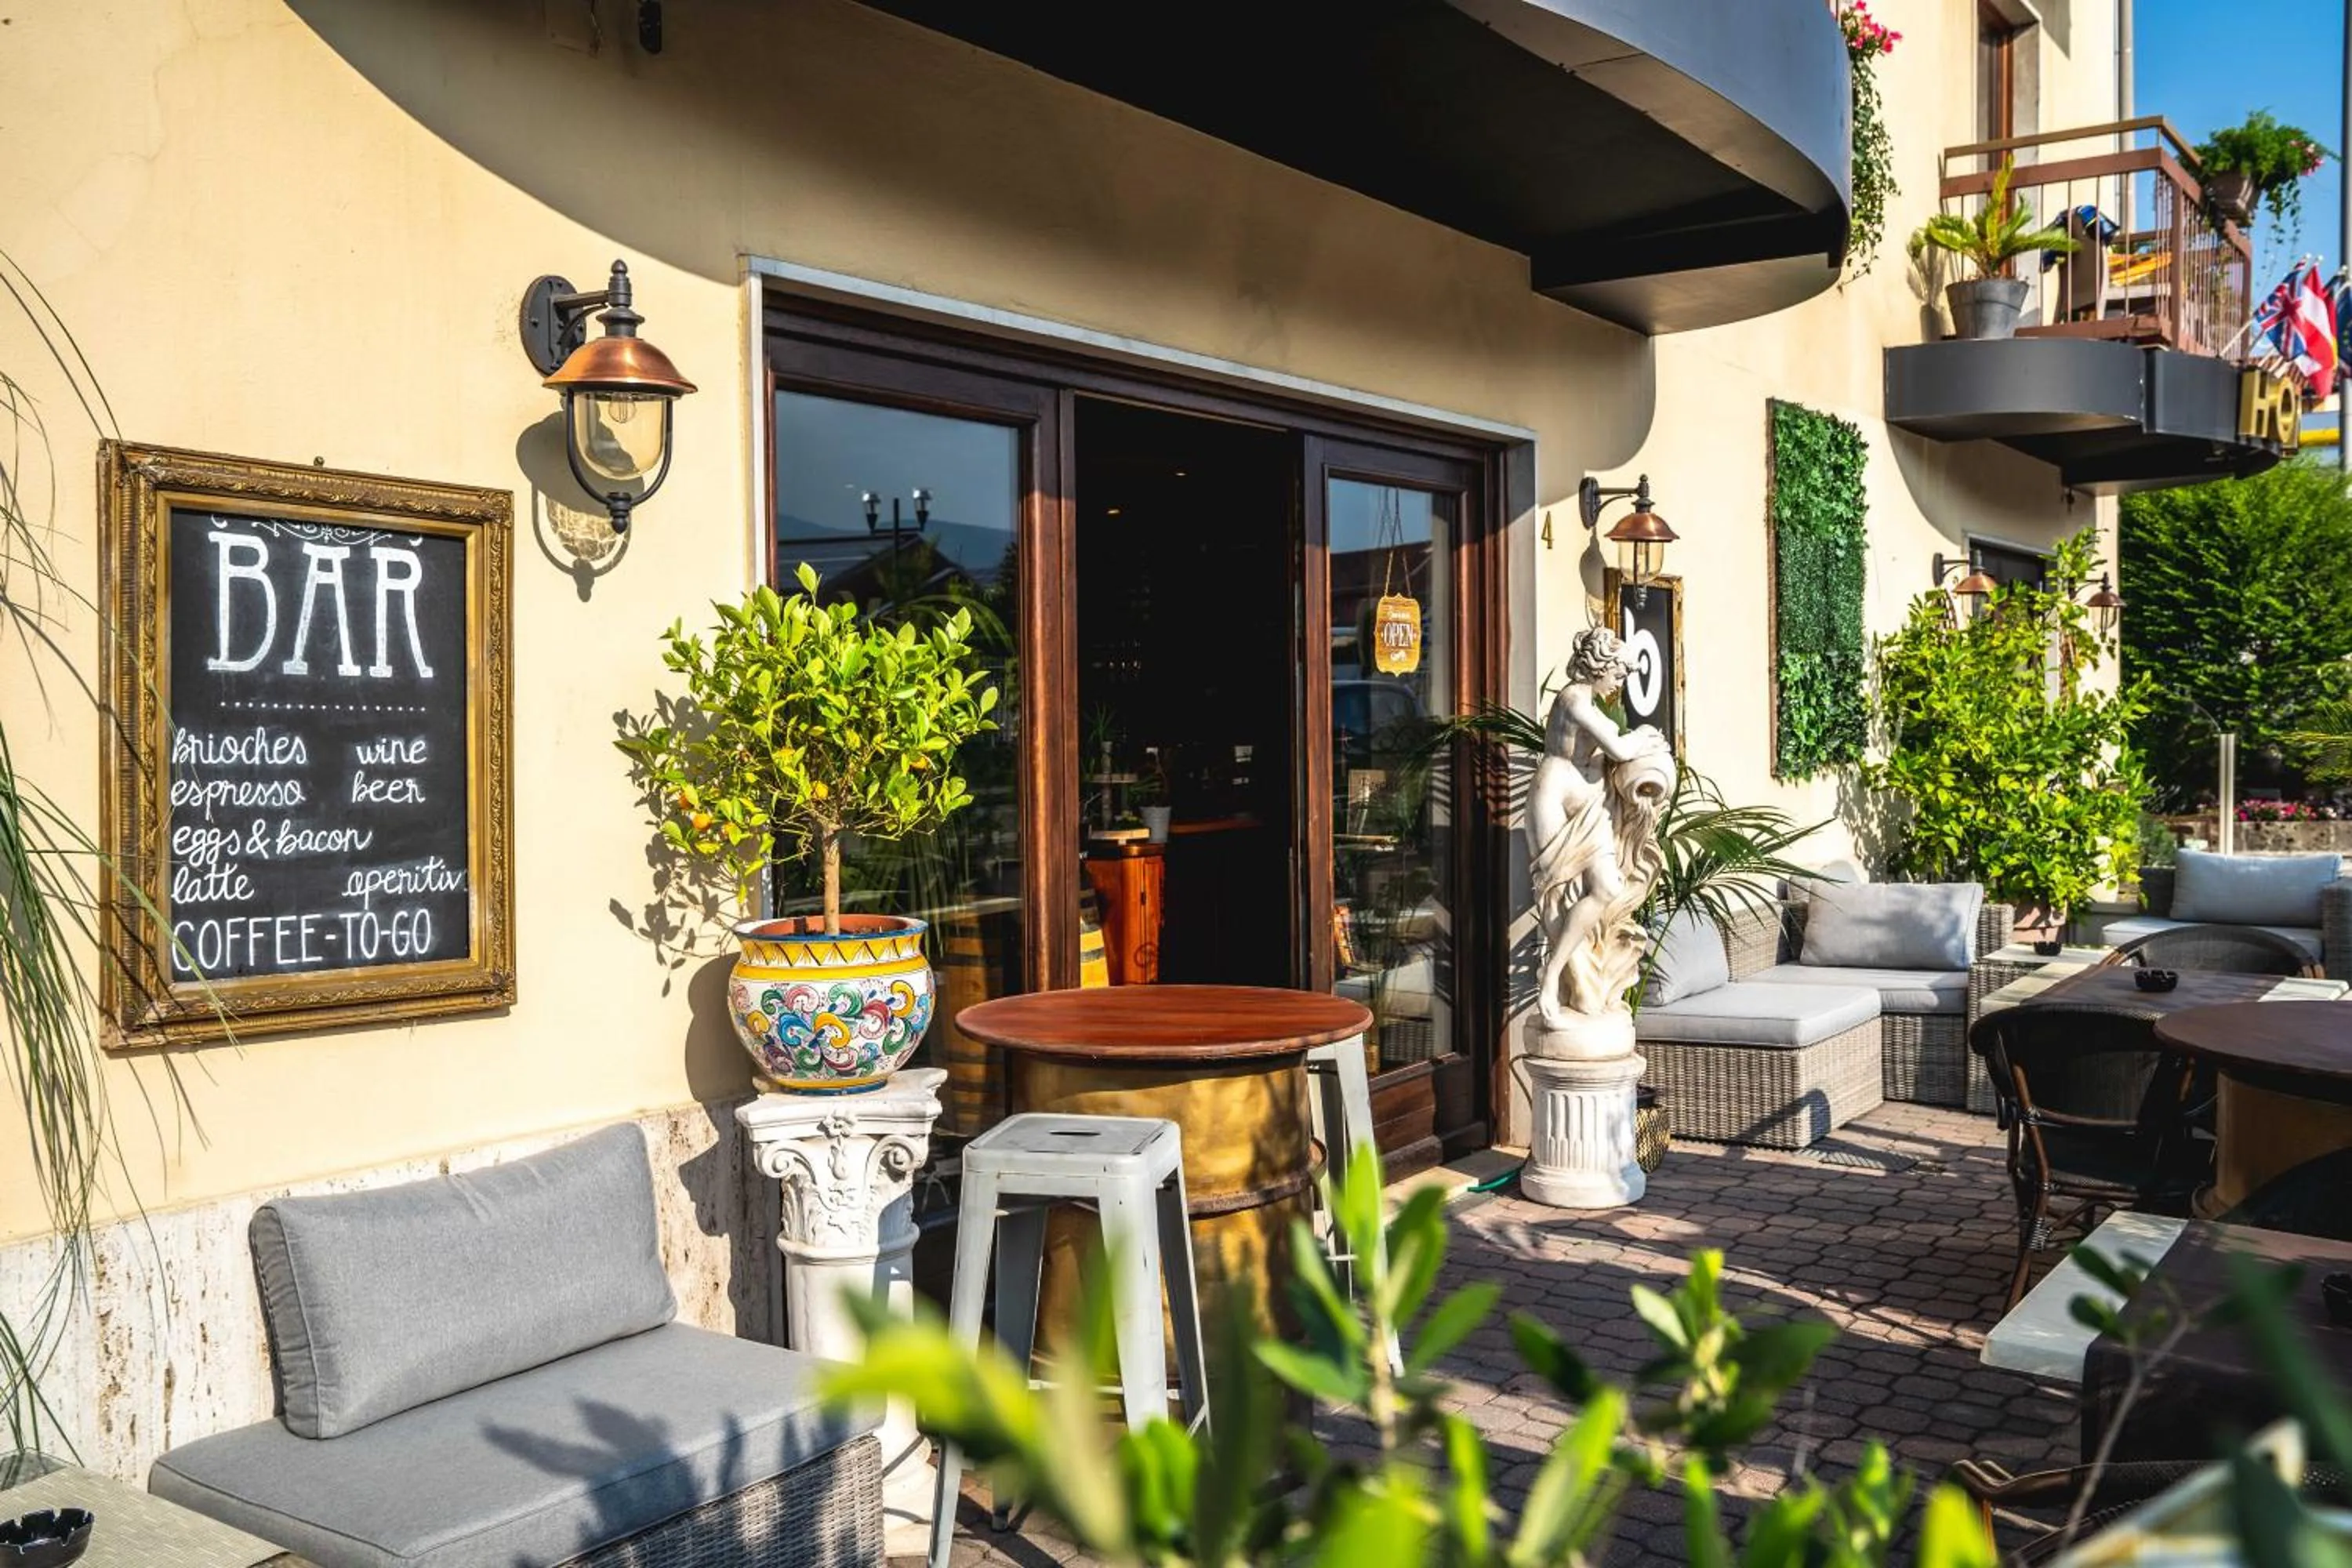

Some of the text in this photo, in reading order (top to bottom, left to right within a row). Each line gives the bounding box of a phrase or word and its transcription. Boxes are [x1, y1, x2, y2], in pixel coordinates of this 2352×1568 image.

[1541, 511, 1554, 550] 4
[207, 531, 434, 678] BAR
[1384, 622, 1414, 647] OPEN
[172, 727, 308, 765] brioches
[356, 738, 427, 764] wine
[170, 779, 307, 821] espresso
[352, 770, 426, 804] beer
[172, 818, 372, 867] eggs & bacon
[171, 861, 255, 904] latte
[341, 855, 467, 910] aperitiv
